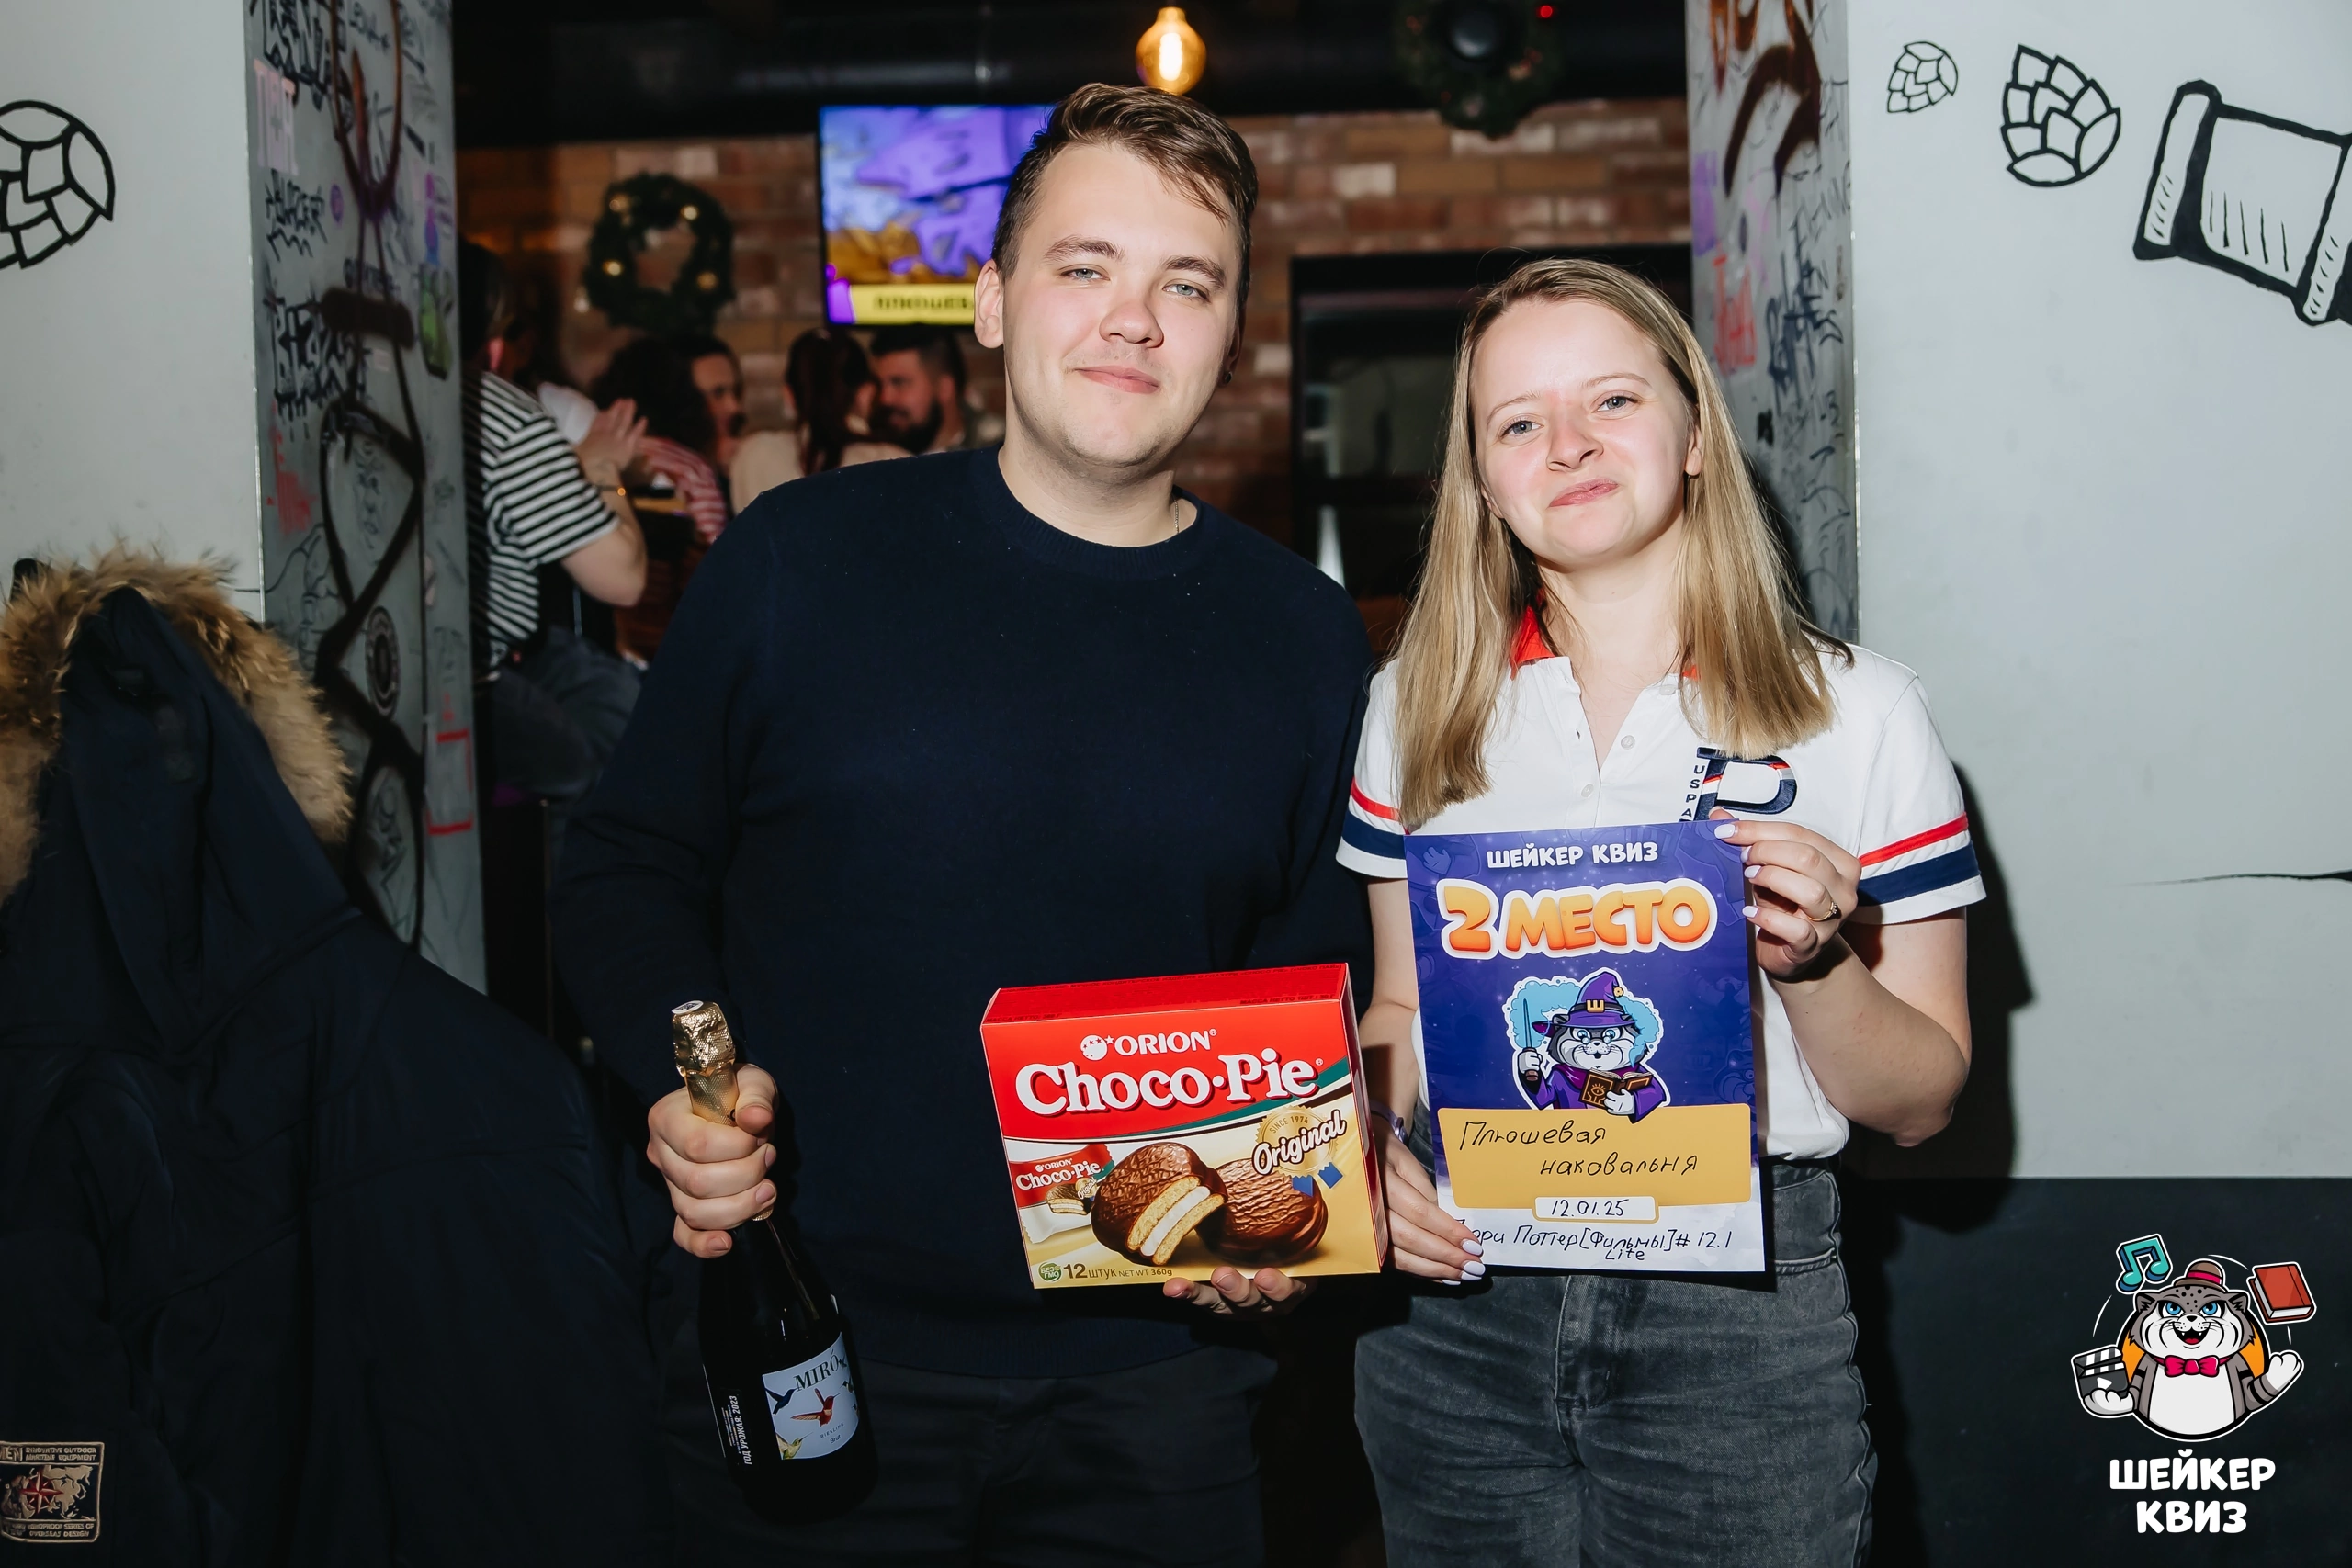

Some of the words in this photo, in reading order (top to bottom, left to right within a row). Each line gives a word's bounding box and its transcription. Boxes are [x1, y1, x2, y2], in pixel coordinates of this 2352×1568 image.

[1487, 843, 1584, 869] ШЕЙКЕР
[1592, 841, 1658, 864] КВИЗ
[1442, 884, 1493, 953] 2
[1505, 884, 1710, 953] МЕСТО
[1270, 1117, 1289, 1134] SINCE
[1290, 1115, 1309, 1124] 1974
[1252, 1109, 1348, 1176] Original
[1460, 1120, 1606, 1151] Плюшевая
[1540, 1152, 1699, 1177] наковальня
[1078, 1176, 1098, 1200] Original
[1551, 1199, 1630, 1218] 12.01.25
[1604, 1248, 1645, 1261] Lite
[1064, 1263, 1088, 1280] 12
[1118, 1269, 1135, 1278] NET
[1136, 1269, 1149, 1277] WT
[729, 1395, 741, 1415] 2023
[820, 1422, 845, 1438] RIESLING
[830, 1434, 842, 1445] Brut
[58, 1454, 96, 1462] EQUIPMENT
[741, 1450, 752, 1465] ГОД
